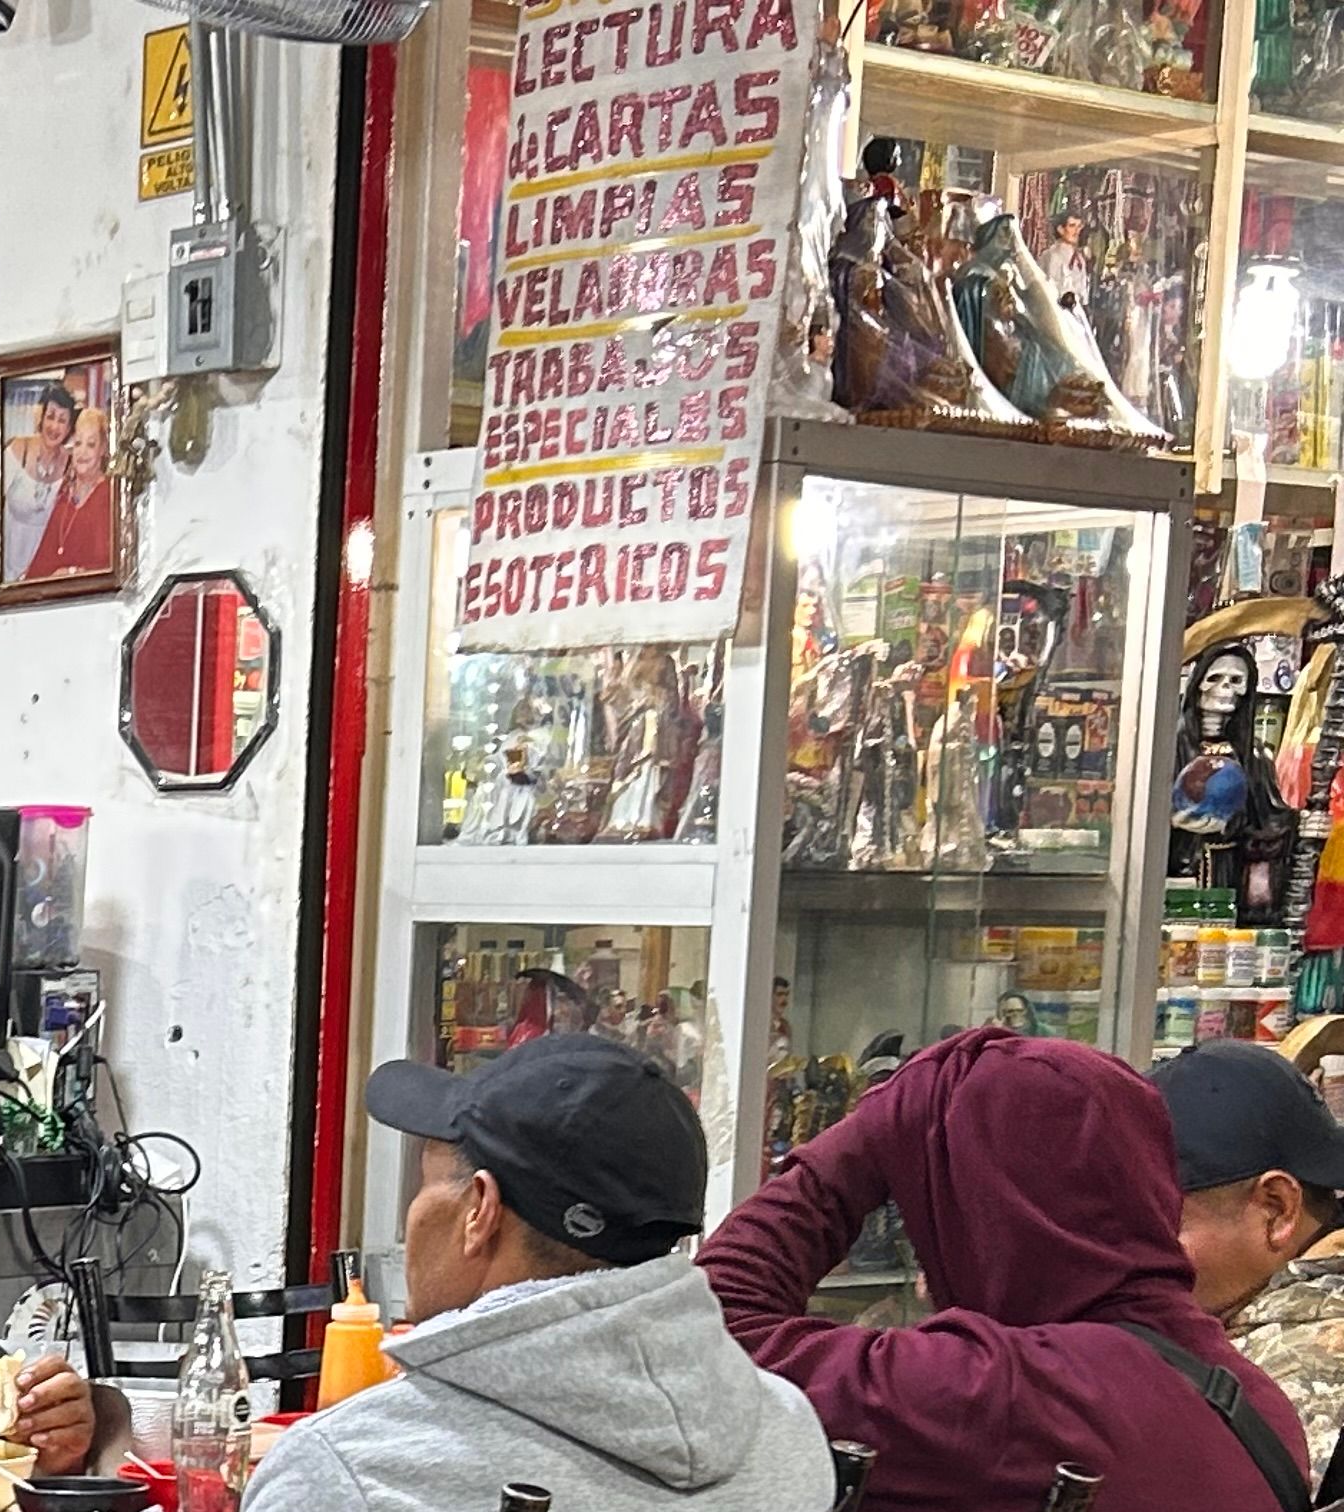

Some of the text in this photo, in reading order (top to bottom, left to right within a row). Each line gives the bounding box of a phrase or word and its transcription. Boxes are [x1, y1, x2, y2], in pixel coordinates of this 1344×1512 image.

[514, 0, 798, 97] LECTURA
[147, 150, 191, 170] PELIG
[544, 69, 781, 174] CARTAS
[154, 177, 190, 194] VOLTA
[505, 163, 759, 259] LIMPIAS
[497, 239, 776, 329] VELADORAS
[488, 321, 760, 408] TRABAJOS
[483, 386, 749, 470] ESPECIALES
[472, 457, 749, 544] PRODUCTOS
[463, 538, 732, 624] ESOTERICOS
